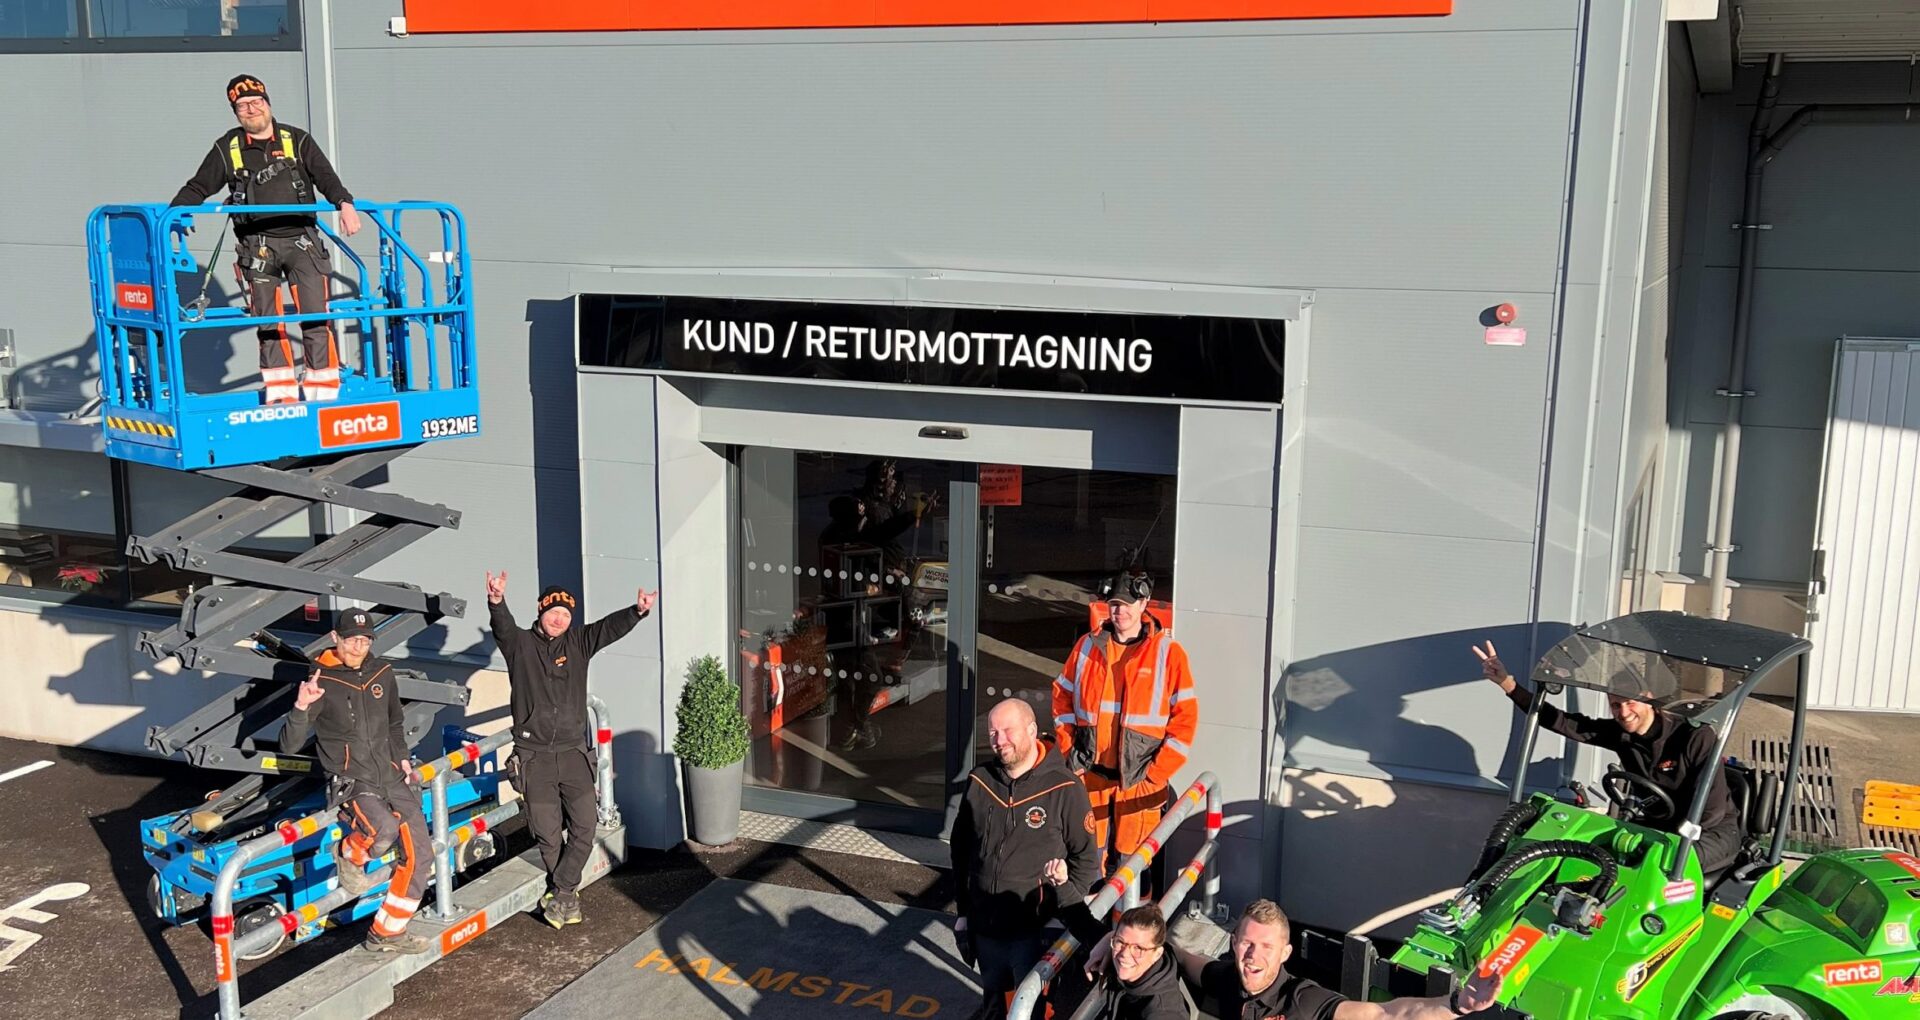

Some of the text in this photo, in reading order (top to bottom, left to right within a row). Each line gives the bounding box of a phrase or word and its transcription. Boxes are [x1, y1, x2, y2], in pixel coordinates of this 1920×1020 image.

[124, 289, 148, 304] renta
[683, 319, 775, 354] KUND
[806, 324, 1153, 373] RETURMOTTAGNING
[333, 413, 388, 437] renta
[421, 415, 479, 438] 1932ME
[451, 921, 479, 945] renta
[214, 943, 225, 976] renta
[1489, 937, 1526, 971] renta
[633, 948, 941, 1018] HALMSTAD
[1827, 964, 1881, 984] renta
